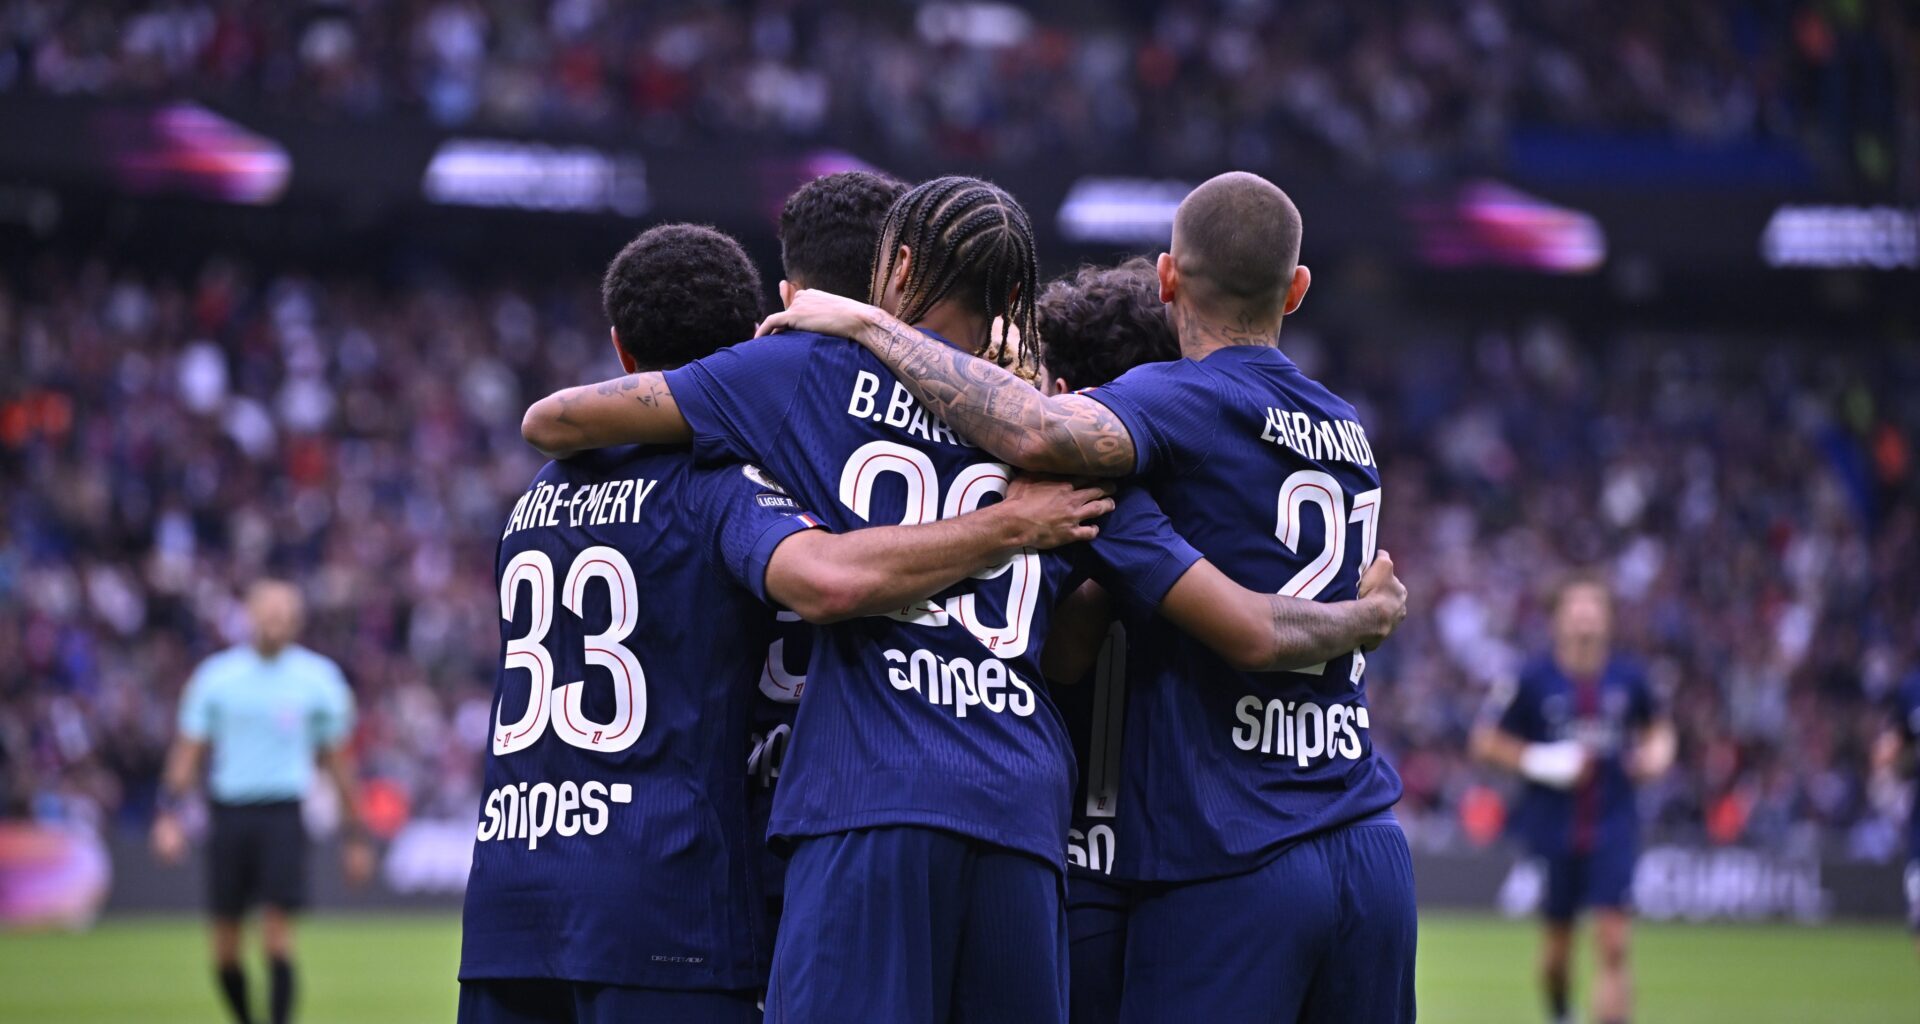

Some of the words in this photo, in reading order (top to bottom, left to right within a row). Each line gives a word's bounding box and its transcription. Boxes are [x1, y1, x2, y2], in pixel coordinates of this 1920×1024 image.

[1276, 470, 1381, 686] 21
[493, 546, 647, 755] 33
[1232, 695, 1364, 767] snipes
[477, 780, 608, 850] snipes
